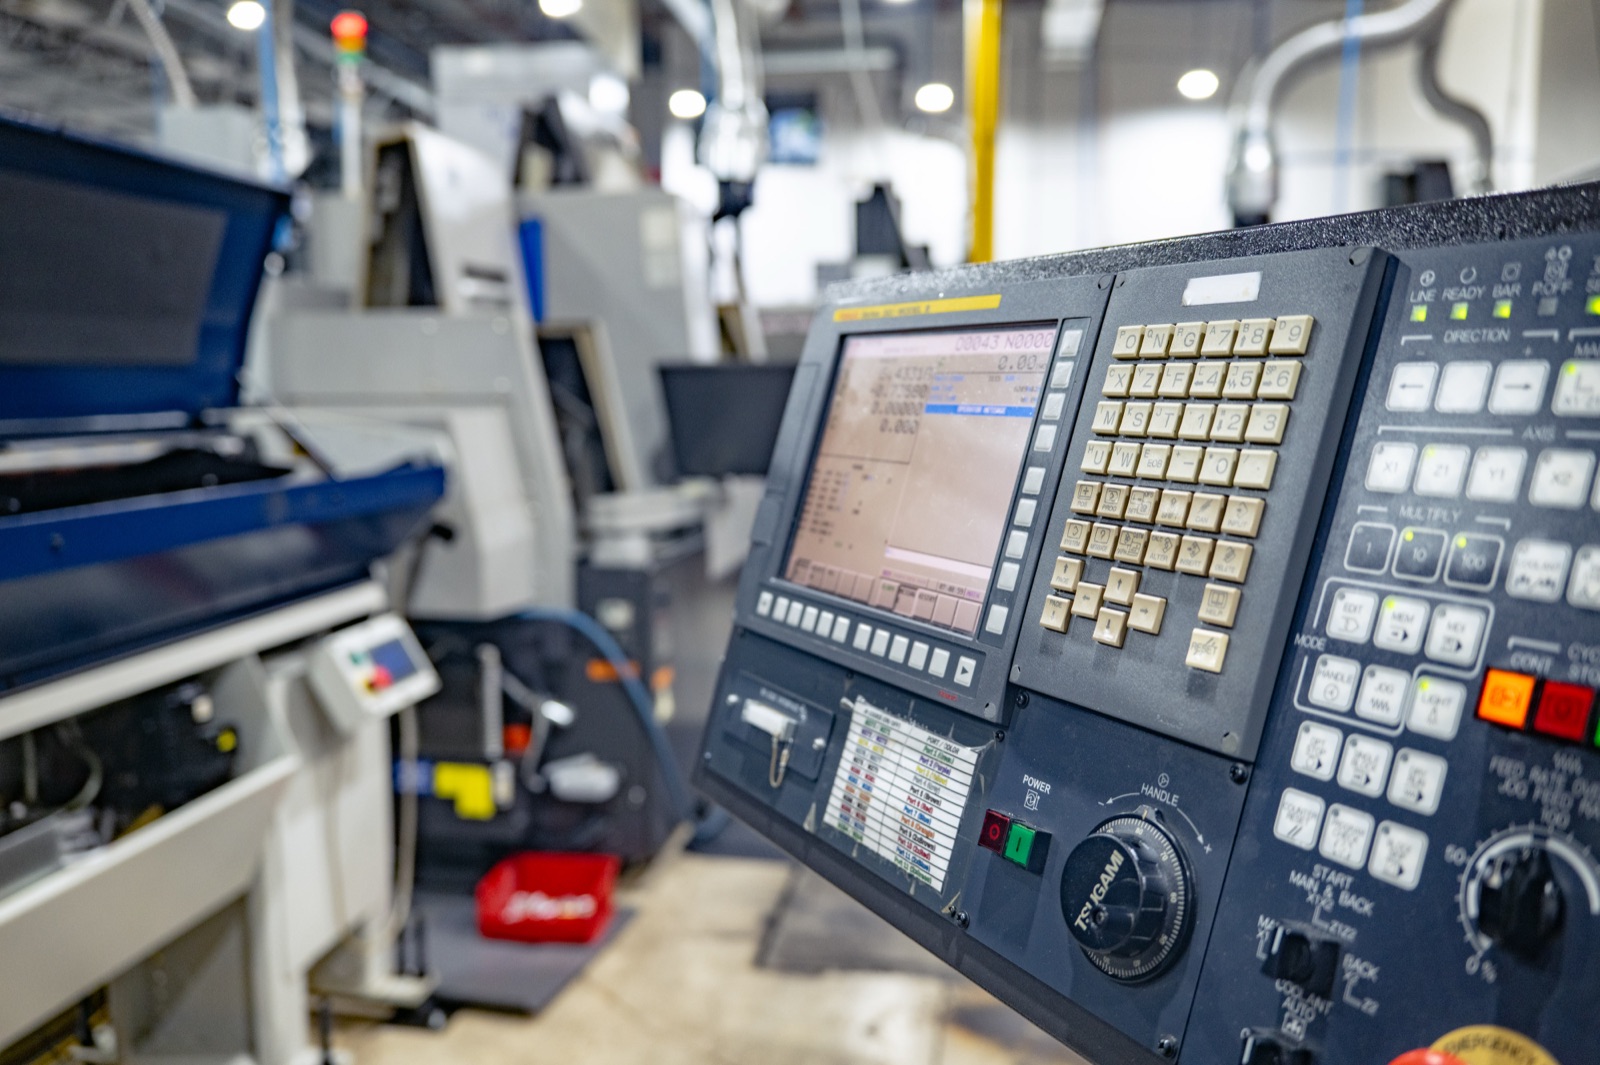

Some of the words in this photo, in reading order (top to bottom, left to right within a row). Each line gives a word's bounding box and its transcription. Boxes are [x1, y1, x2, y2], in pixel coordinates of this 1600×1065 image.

[1409, 288, 1437, 302] LINE
[1442, 285, 1486, 300] READY
[1492, 282, 1521, 298] BAR
[1153, 333, 1165, 348] N
[1184, 332, 1196, 348] G
[1218, 330, 1231, 346] 7
[1251, 328, 1265, 344] 8
[1288, 324, 1302, 342] 9
[1443, 327, 1511, 344] DIRECTION
[1114, 373, 1126, 388] X
[1142, 373, 1154, 388] Z
[1172, 372, 1185, 388] F
[1206, 370, 1219, 386] 4
[1240, 371, 1254, 387] 5
[1276, 370, 1290, 387] 6
[1104, 410, 1117, 426] M
[1132, 412, 1144, 428] S
[1164, 412, 1175, 428] T
[1227, 414, 1242, 431] 2
[1263, 414, 1278, 432] 3
[1521, 426, 1556, 441] AXIS
[1094, 451, 1104, 466] U
[1120, 452, 1134, 467] W
[1146, 458, 1162, 468] EOB
[1102, 504, 1118, 512] PROG
[1399, 505, 1463, 523] MULTIPLY
[1195, 516, 1209, 524] CAN
[1228, 520, 1248, 528] INPUT
[1412, 548, 1428, 562] 10
[1460, 554, 1487, 572] 100
[1055, 576, 1070, 584] PAGE
[1205, 608, 1224, 617] HELP
[1343, 603, 1362, 614] EDIT
[1391, 612, 1414, 624] MEM
[1191, 641, 1218, 656] RESET
[1294, 633, 1327, 651] MODE
[926, 734, 940, 746] PORT
[1022, 774, 1051, 794] POWER
[1141, 783, 1179, 806] HANDLE
[1312, 864, 1355, 889] START
[1289, 870, 1320, 893] MAIN
[1338, 890, 1375, 917] BACK
[1342, 953, 1380, 983] BACK
[1275, 978, 1335, 1016] COOLANT
[1282, 996, 1316, 1023] AUTO
